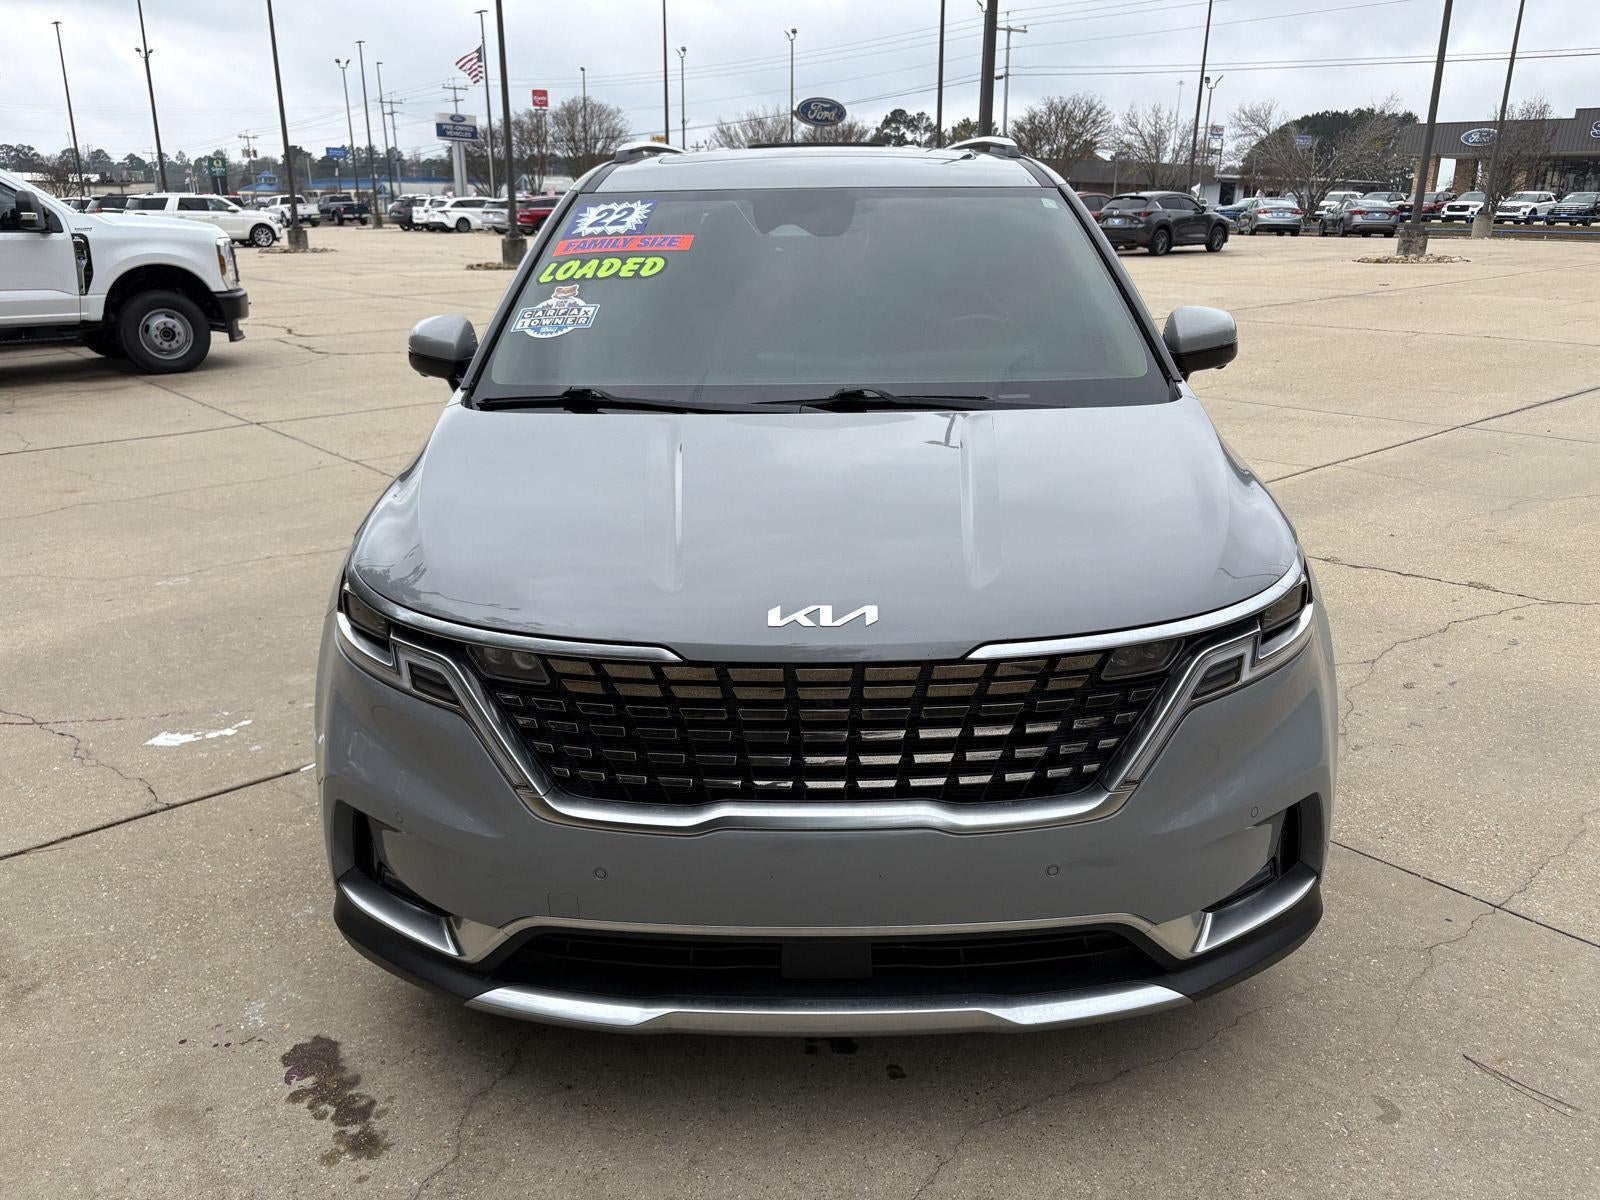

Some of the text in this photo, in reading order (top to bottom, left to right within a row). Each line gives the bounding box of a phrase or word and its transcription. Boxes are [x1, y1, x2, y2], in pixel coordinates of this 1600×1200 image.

[808, 102, 838, 120] Ford
[445, 130, 473, 138] VEHICLES
[587, 207, 636, 228] 22
[564, 236, 682, 253] FAMILY SIZE
[538, 256, 666, 284] LOADED
[523, 307, 591, 318] CARFAX
[530, 317, 588, 327] OWNER
[767, 605, 879, 627] KIA
